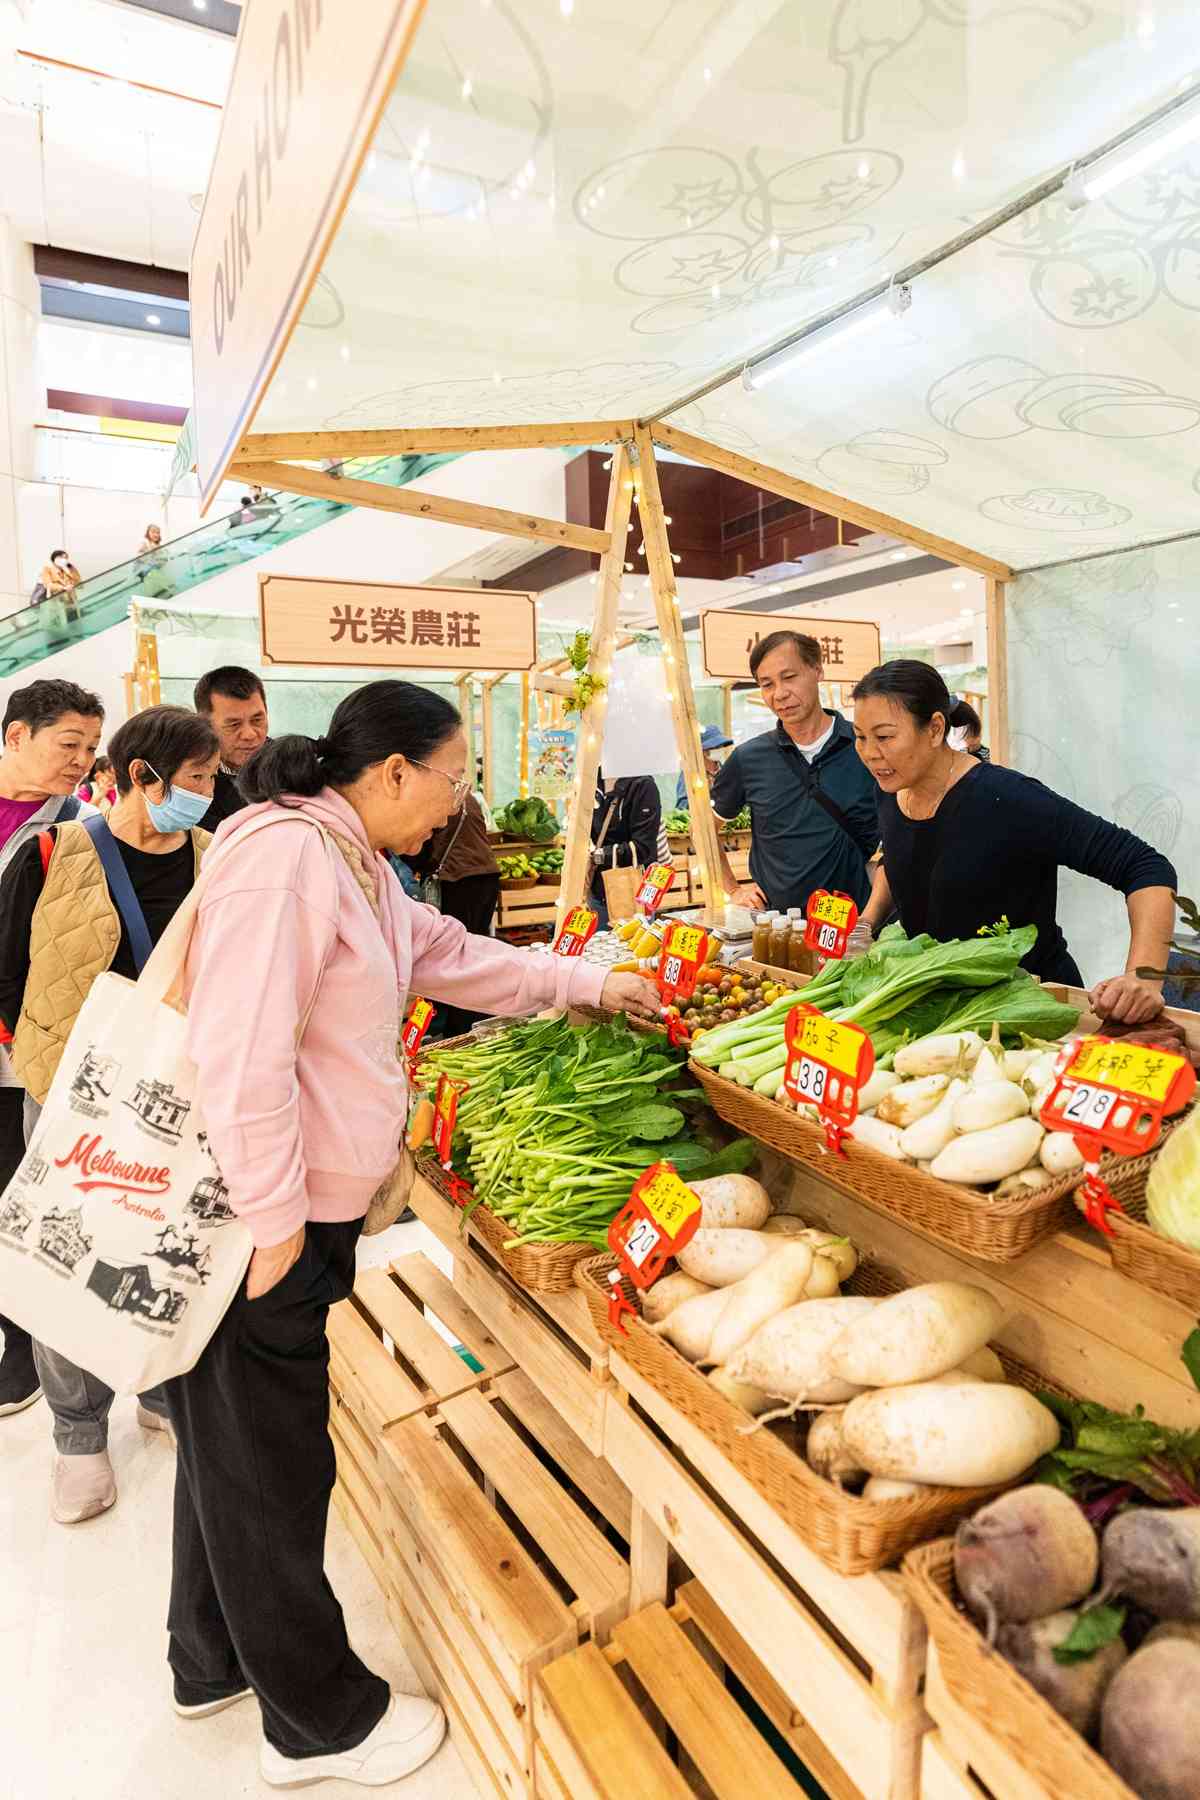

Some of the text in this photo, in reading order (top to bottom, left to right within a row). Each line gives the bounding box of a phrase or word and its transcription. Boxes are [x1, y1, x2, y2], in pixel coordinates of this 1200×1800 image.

[213, 170, 251, 356] OUR
[329, 604, 481, 648] 光榮農莊
[822, 928, 836, 948] 18
[665, 960, 680, 982] 38
[805, 1020, 842, 1053] 茄子
[800, 1063, 824, 1097] 38
[1067, 1088, 1110, 1117] 28
[54, 1132, 171, 1188] Melbourne
[112, 1193, 167, 1222] Australia
[628, 1224, 656, 1253] 20
